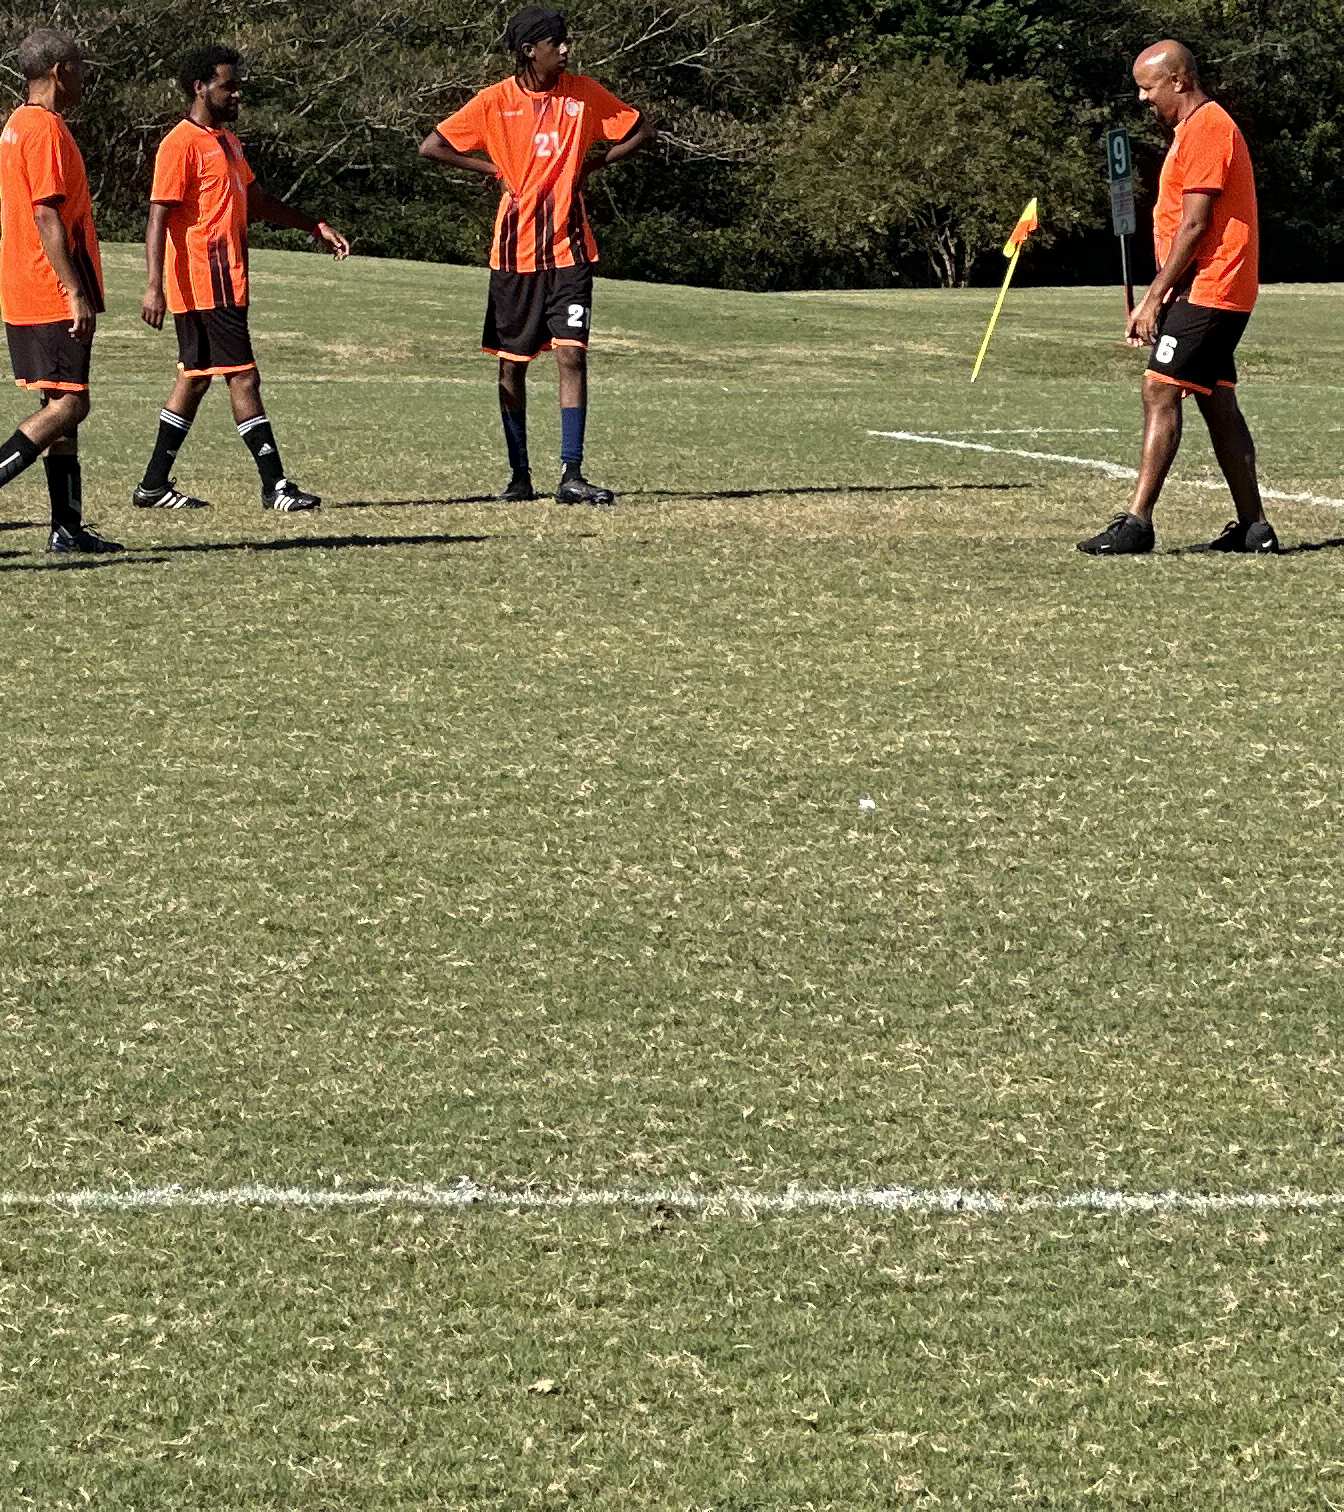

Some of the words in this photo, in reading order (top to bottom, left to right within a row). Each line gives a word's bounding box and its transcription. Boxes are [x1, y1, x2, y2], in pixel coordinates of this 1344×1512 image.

[535, 131, 561, 157] 21
[1114, 136, 1126, 174] 9
[1156, 335, 1177, 363] 6
